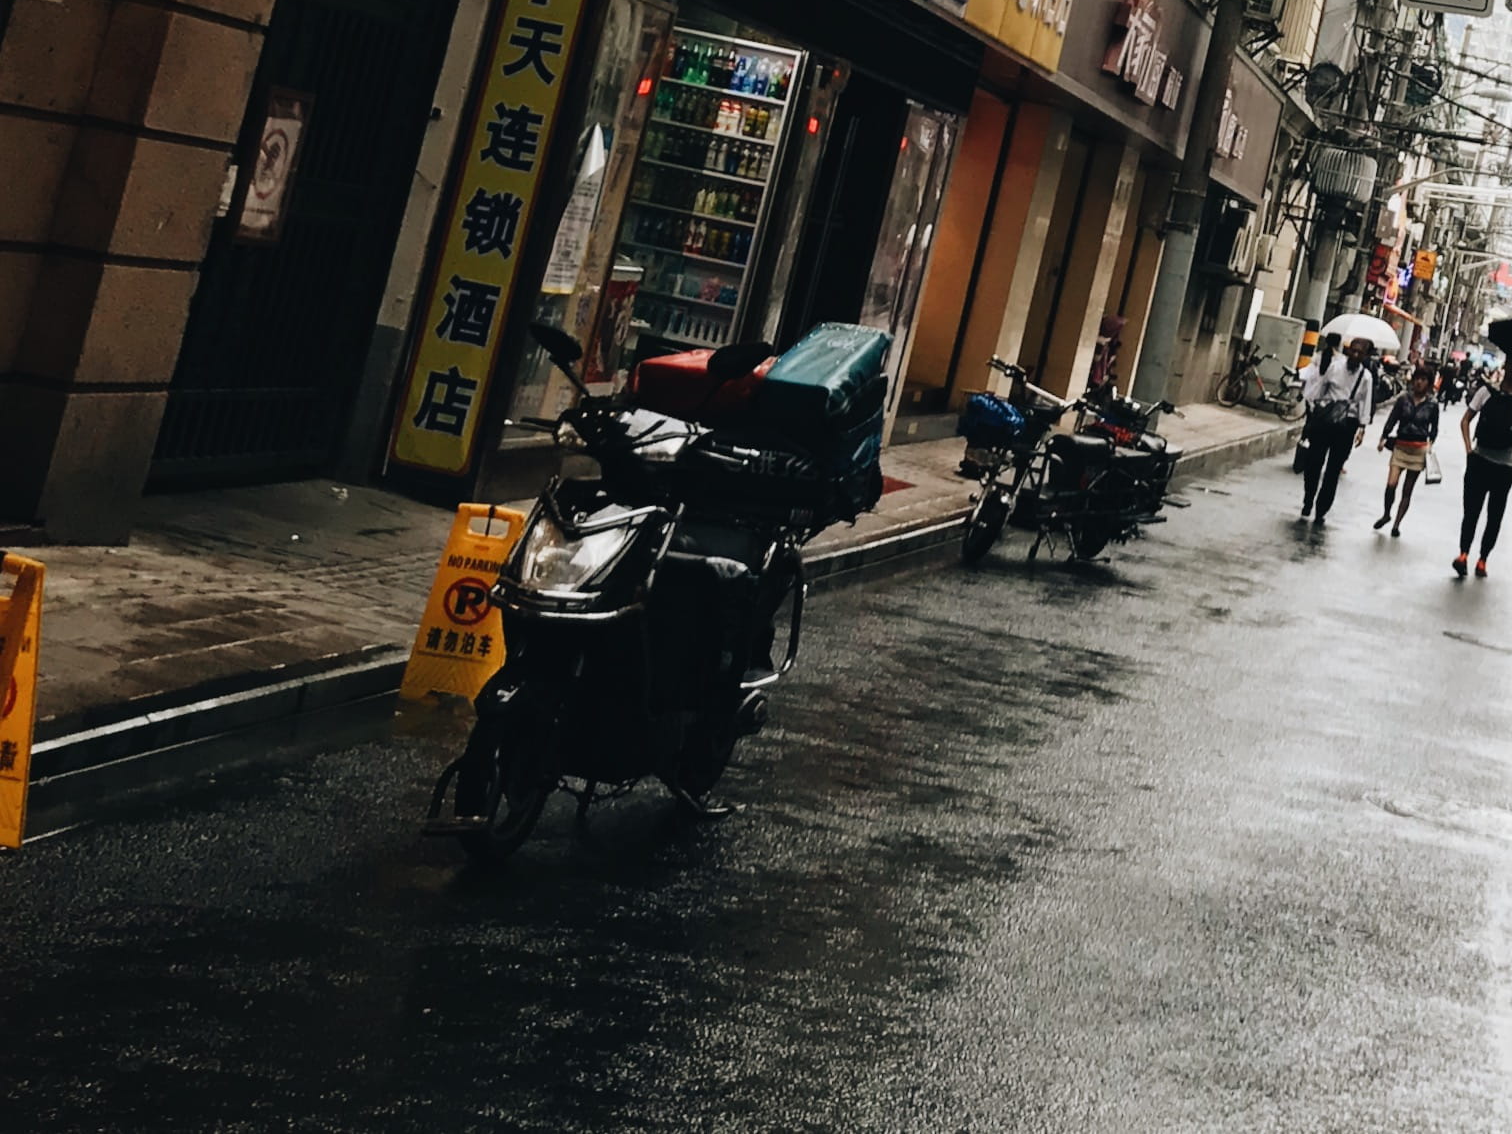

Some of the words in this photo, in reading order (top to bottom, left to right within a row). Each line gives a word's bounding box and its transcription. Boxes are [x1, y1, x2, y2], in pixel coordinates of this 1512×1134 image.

[448, 553, 464, 569] NO
[465, 557, 499, 572] PARKIN
[427, 627, 493, 657] 请勿泊车
